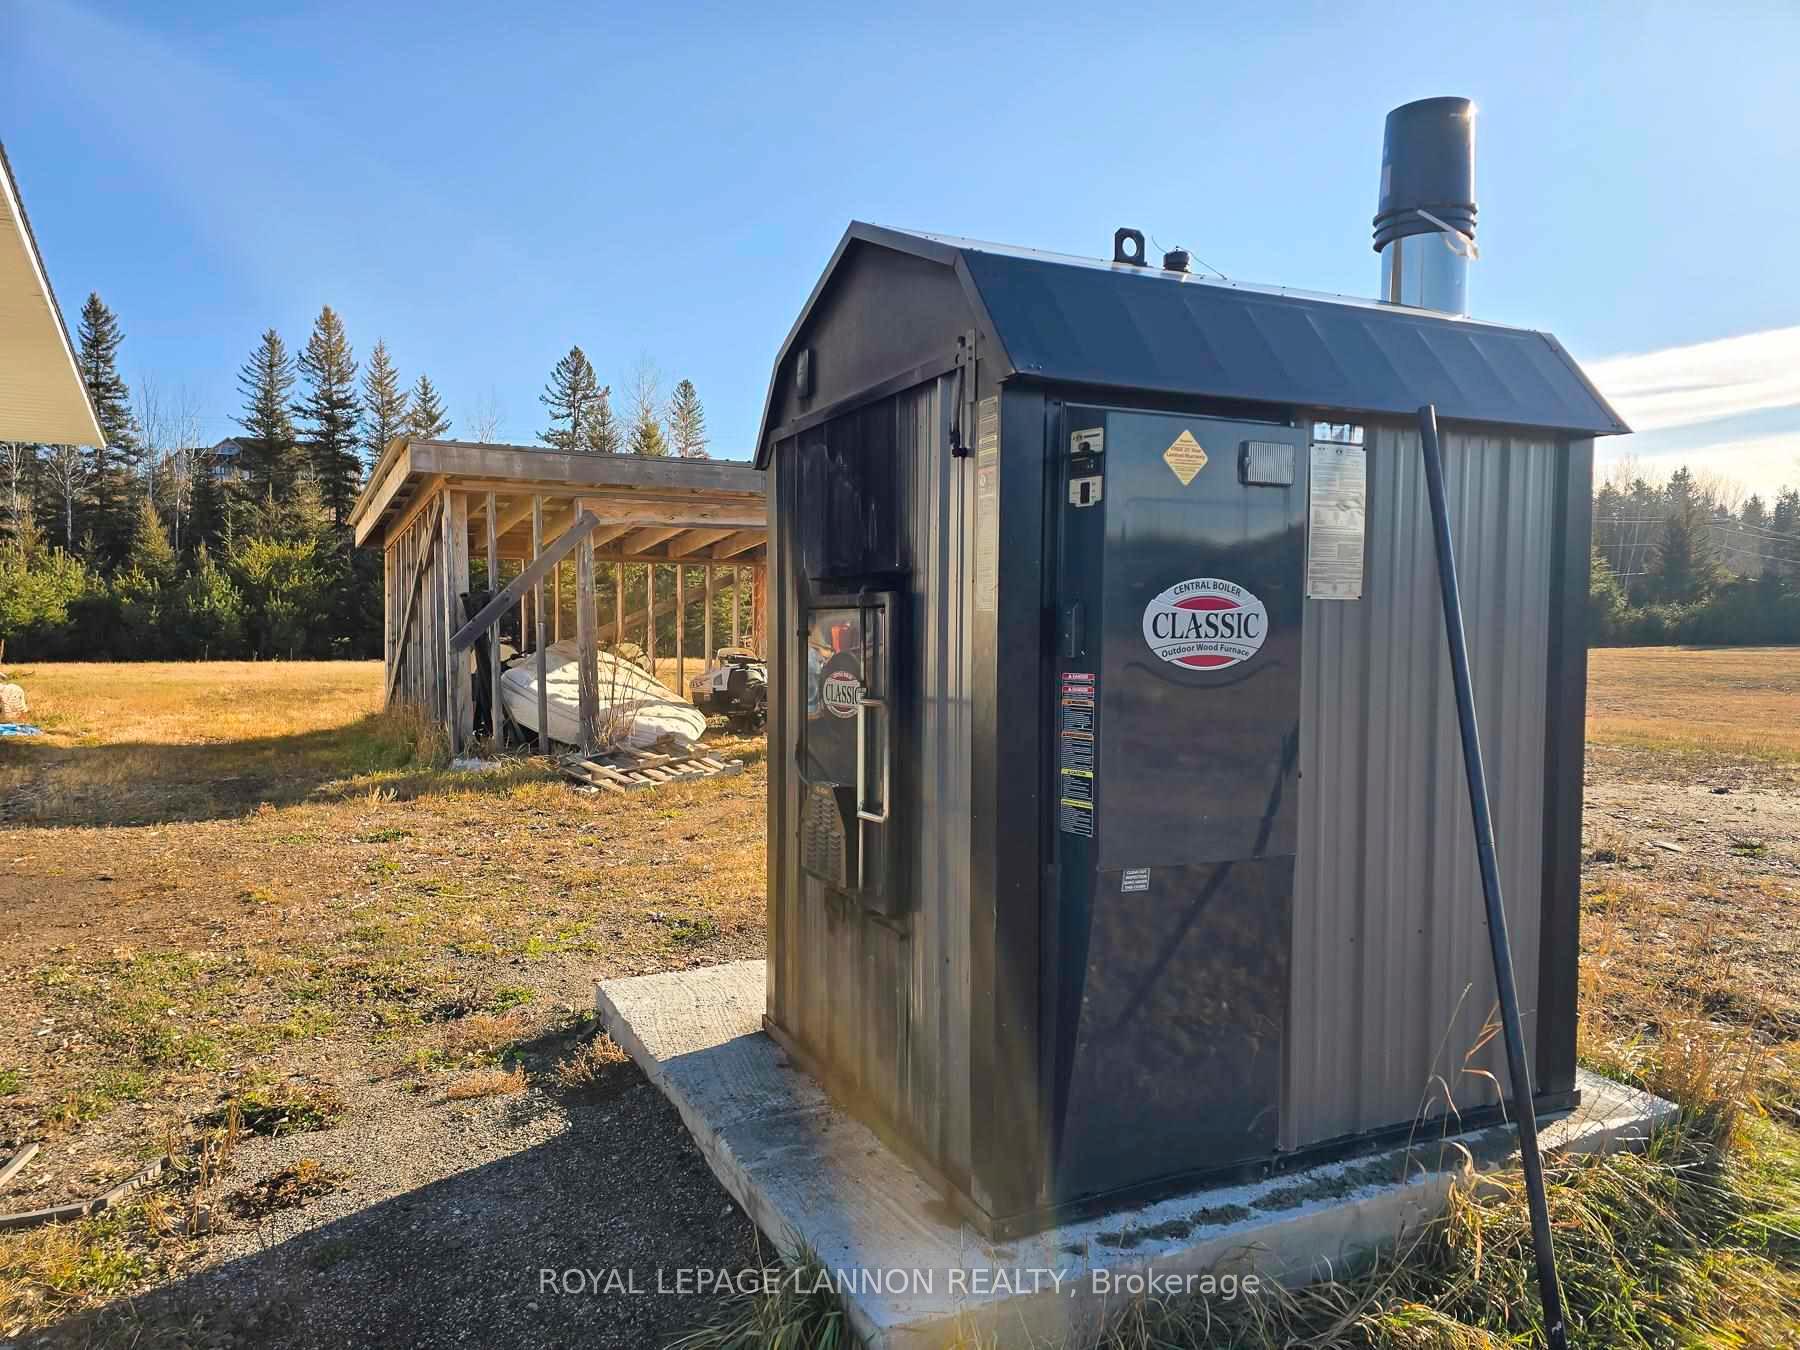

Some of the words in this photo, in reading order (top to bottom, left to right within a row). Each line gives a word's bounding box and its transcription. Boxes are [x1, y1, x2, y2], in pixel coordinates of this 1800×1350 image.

[1174, 580, 1211, 595] CENTRAL
[1213, 582, 1242, 597] BOILER
[1152, 612, 1260, 639] CLASSIC
[1162, 645, 1195, 658] Outdoor
[1196, 643, 1218, 652] Wood
[1220, 645, 1249, 657] Furnace
